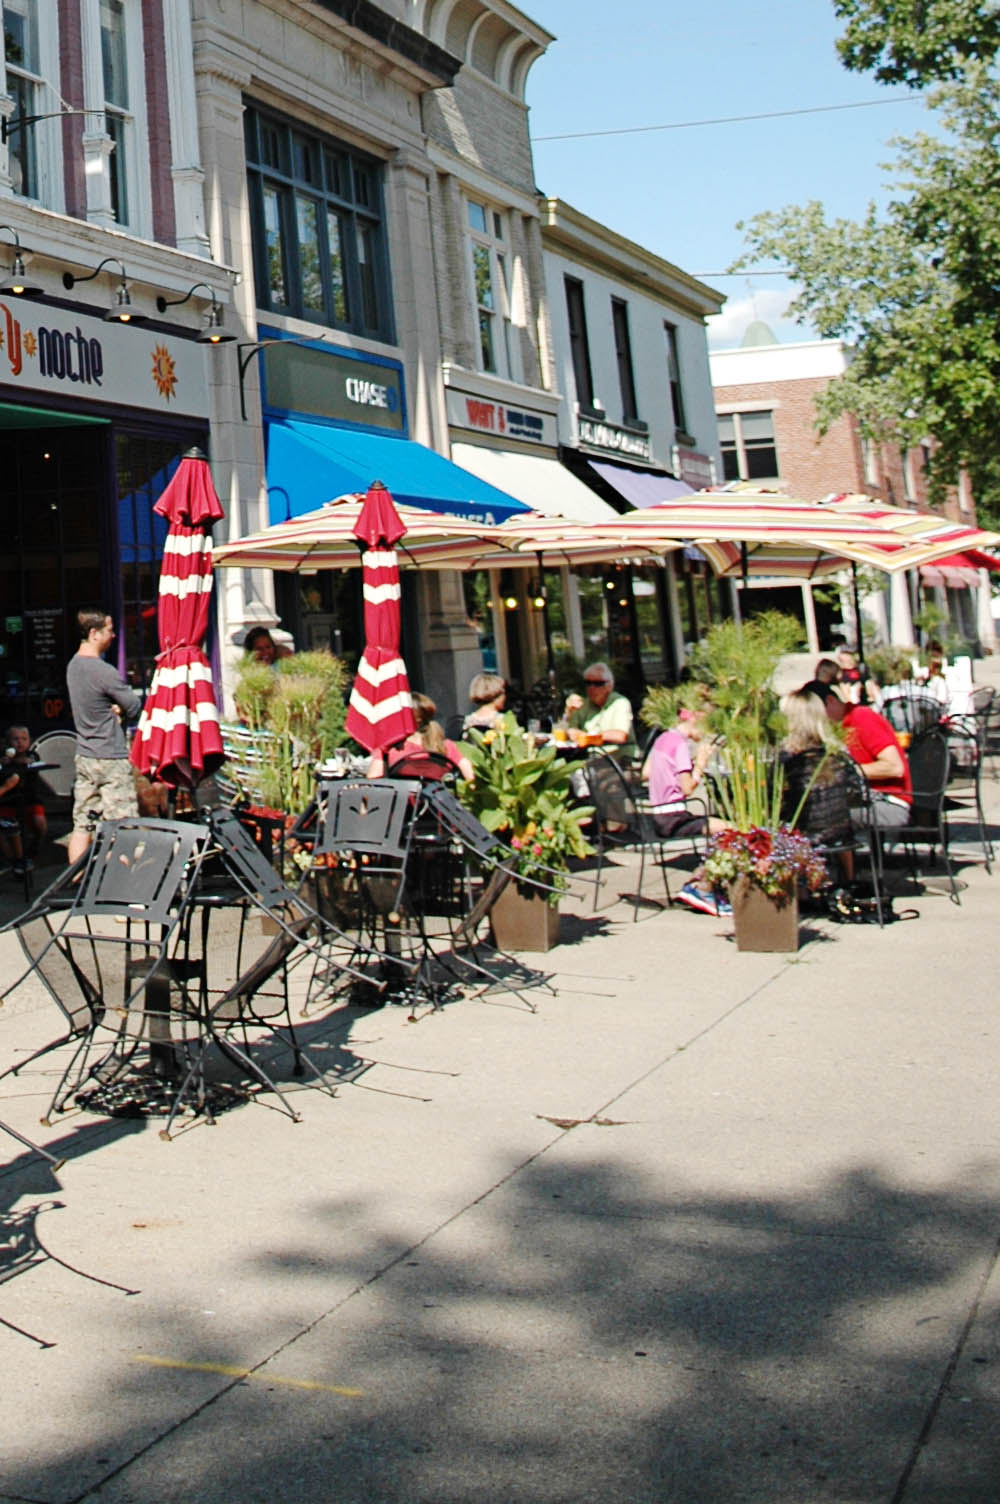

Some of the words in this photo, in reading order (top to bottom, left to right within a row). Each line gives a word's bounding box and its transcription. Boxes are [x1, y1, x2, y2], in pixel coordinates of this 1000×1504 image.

[38, 325, 104, 386] noche
[345, 377, 388, 409] CHASE
[43, 698, 64, 718] OP
